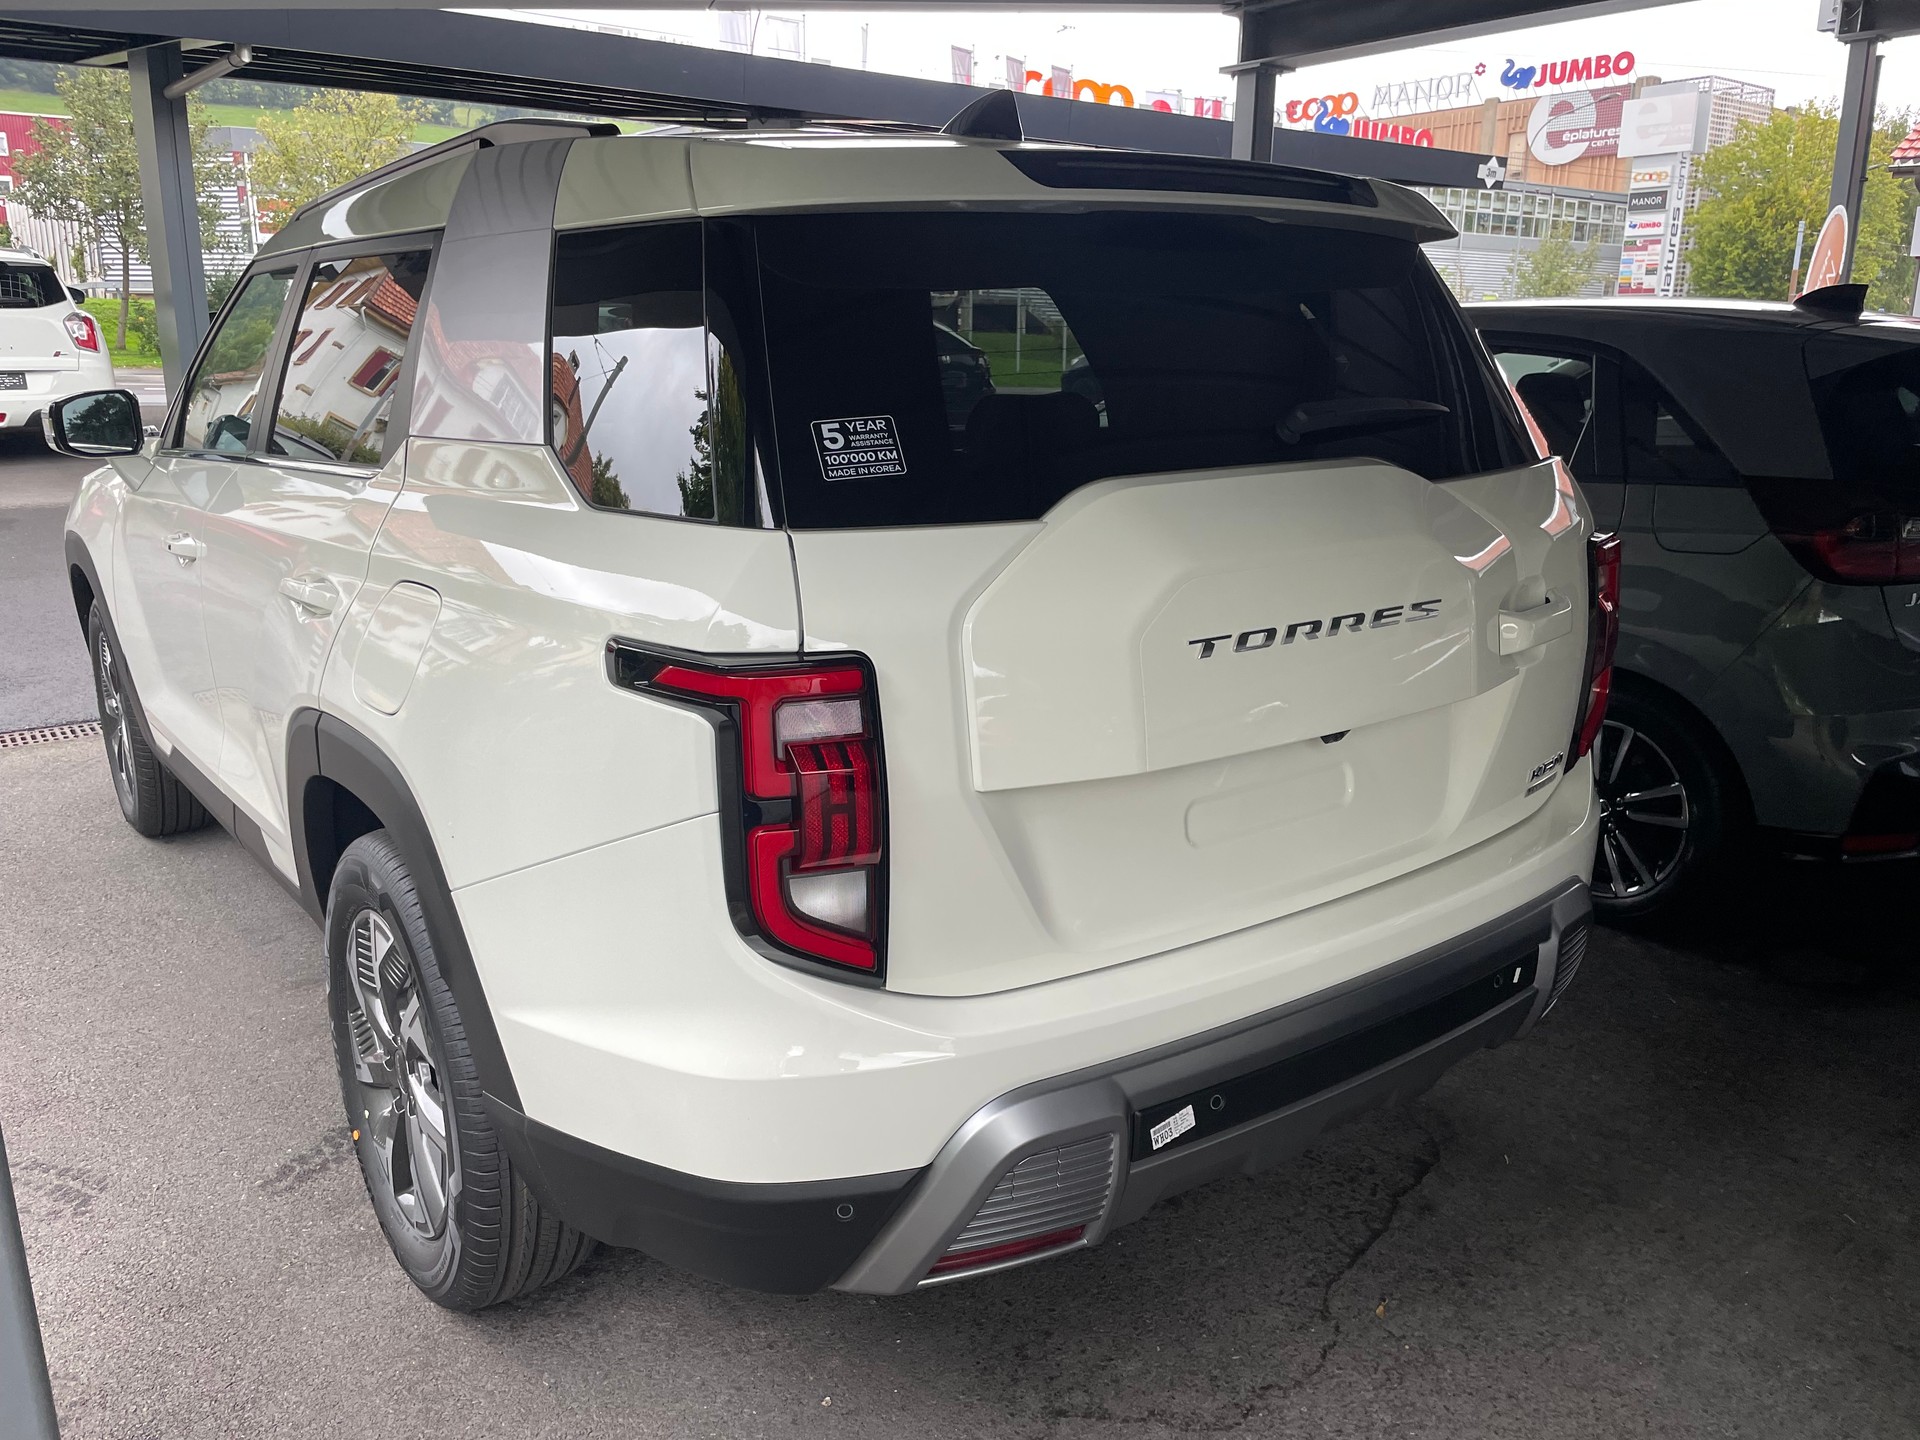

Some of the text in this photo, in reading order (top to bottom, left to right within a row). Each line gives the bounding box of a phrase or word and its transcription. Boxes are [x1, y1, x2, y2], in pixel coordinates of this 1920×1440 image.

[1534, 51, 1635, 88] JUMBO
[1371, 72, 1474, 110] MANOR
[1591, 138, 1619, 148] centr
[1486, 167, 1497, 179] 3m
[1676, 152, 1688, 201] centr
[1631, 196, 1663, 206] MANOR
[1637, 221, 1662, 230] JUMBO
[820, 420, 887, 450] 5 YEAR
[848, 433, 888, 441] WARRANTY
[850, 439, 894, 447] ASSISTANCE
[877, 449, 898, 461] KM
[828, 464, 902, 478] MADE IN KOREA
[1187, 598, 1442, 661] TORRES
